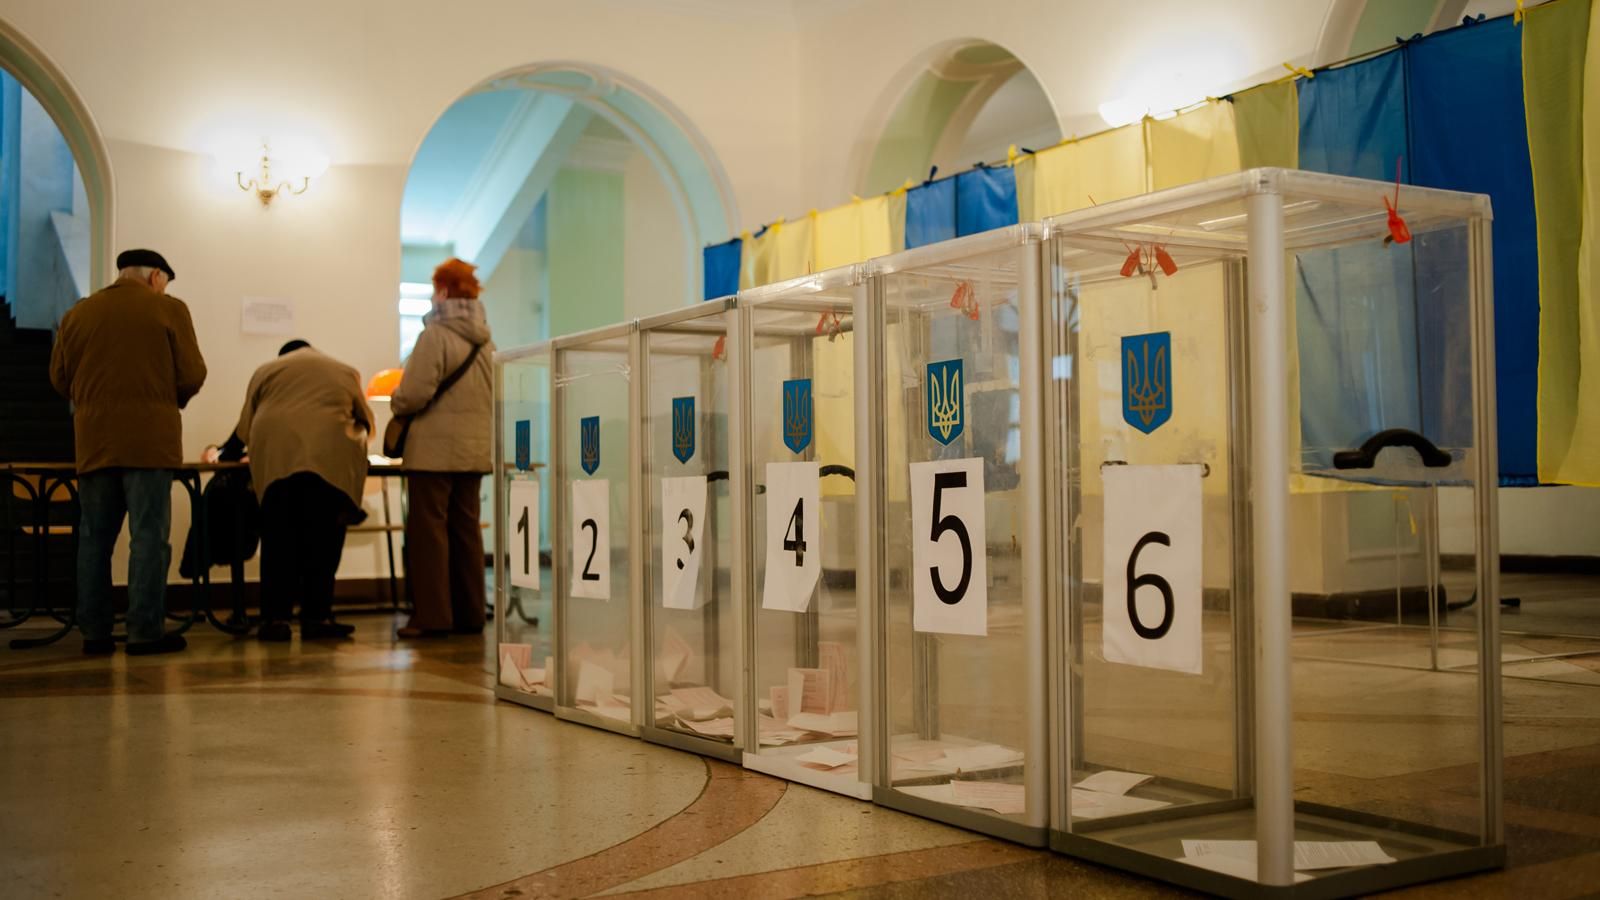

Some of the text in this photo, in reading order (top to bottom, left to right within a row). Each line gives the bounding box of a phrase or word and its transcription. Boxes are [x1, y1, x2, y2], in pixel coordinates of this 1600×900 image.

[517, 506, 530, 575] 1
[581, 518, 600, 581] 2
[676, 508, 695, 570] 3
[784, 497, 807, 567] 4
[929, 470, 973, 606] 5
[1126, 531, 1175, 640] 6
